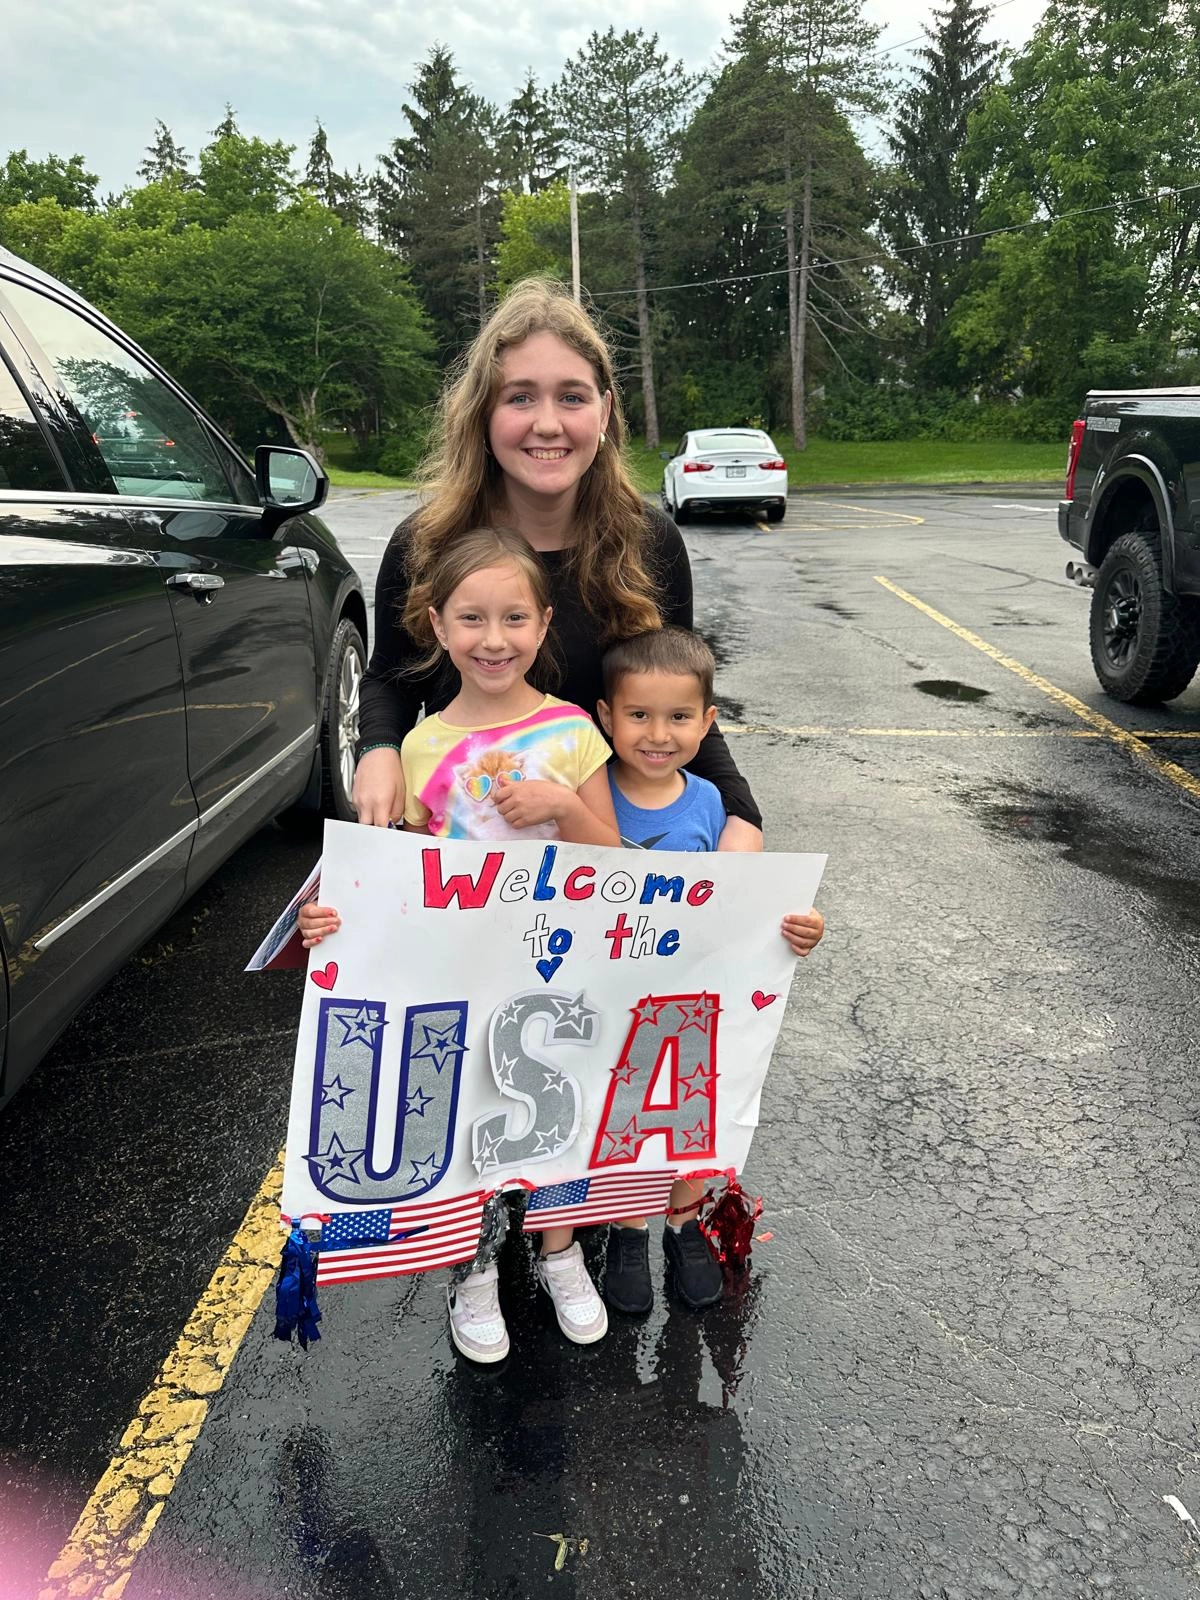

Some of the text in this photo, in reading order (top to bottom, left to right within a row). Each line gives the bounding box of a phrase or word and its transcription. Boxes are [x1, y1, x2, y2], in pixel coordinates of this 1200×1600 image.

[422, 846, 715, 910] Welcome
[523, 912, 681, 960] to the
[302, 989, 722, 1205] USA
